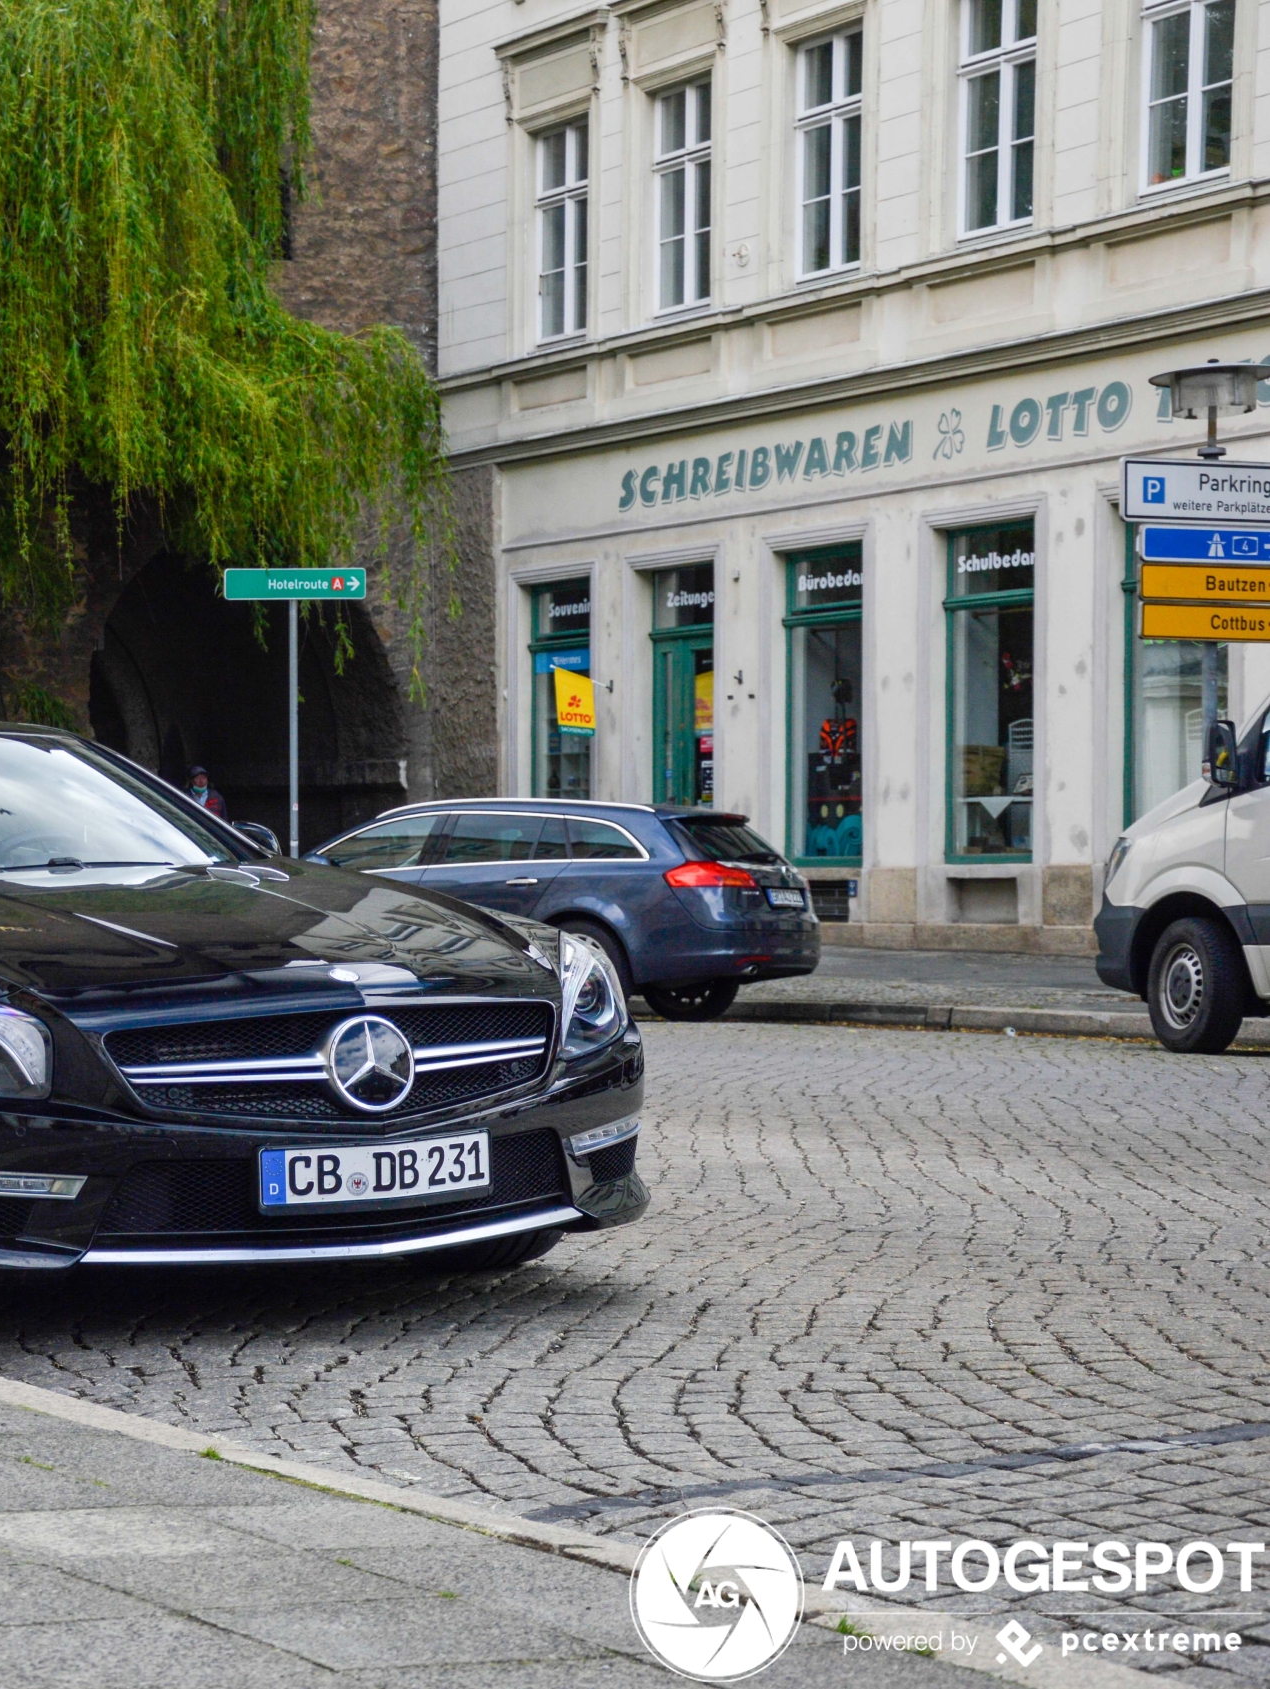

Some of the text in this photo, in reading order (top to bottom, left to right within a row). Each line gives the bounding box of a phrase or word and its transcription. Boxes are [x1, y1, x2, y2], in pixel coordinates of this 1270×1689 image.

[618, 420, 913, 513] SCHREIBWAREN
[986, 381, 1132, 452] LOTTO
[1147, 480, 1161, 501] P
[1199, 473, 1270, 498] Parkring
[1173, 500, 1270, 515] weitere Parkplätze
[1241, 540, 1249, 552] 4
[268, 578, 342, 590] Hotelroute A
[1206, 575, 1266, 592] Bautzen
[1210, 614, 1265, 631] Cottbus
[560, 711, 592, 723] LOTTO
[288, 1140, 485, 1196] CB DB 231
[269, 1183, 279, 1195] D
